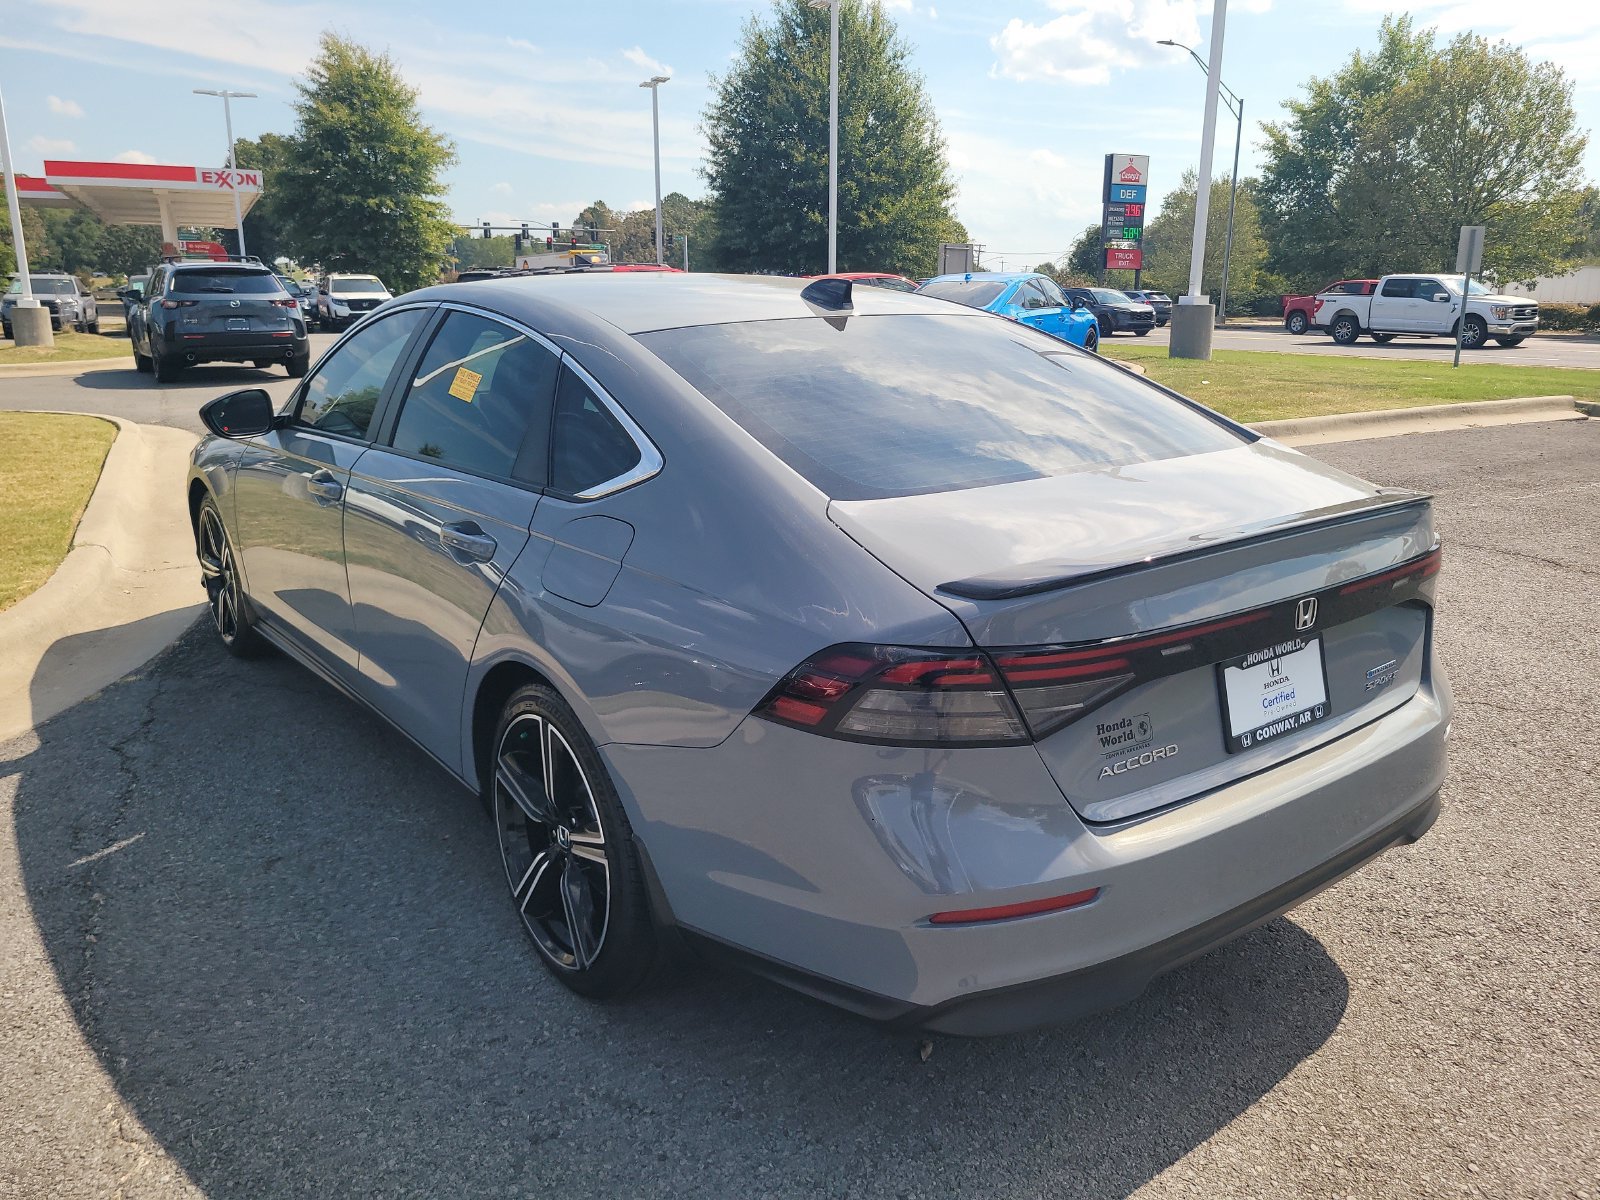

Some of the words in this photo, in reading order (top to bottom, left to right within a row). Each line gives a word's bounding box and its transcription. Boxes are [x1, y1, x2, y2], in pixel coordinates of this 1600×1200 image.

[1120, 189, 1138, 199] DEF
[1115, 252, 1134, 260] TRUCK
[1247, 648, 1274, 666] HONDA
[1274, 639, 1301, 657] WORLD
[1263, 675, 1290, 690] HONDA
[1262, 688, 1296, 709] Certified
[1263, 700, 1297, 717] Pre-Owned
[1096, 718, 1133, 736] Honda
[1256, 718, 1298, 741] CONWAY,
[1299, 711, 1312, 725] AR
[1099, 729, 1134, 748] World
[1098, 743, 1179, 781] ACCORD
